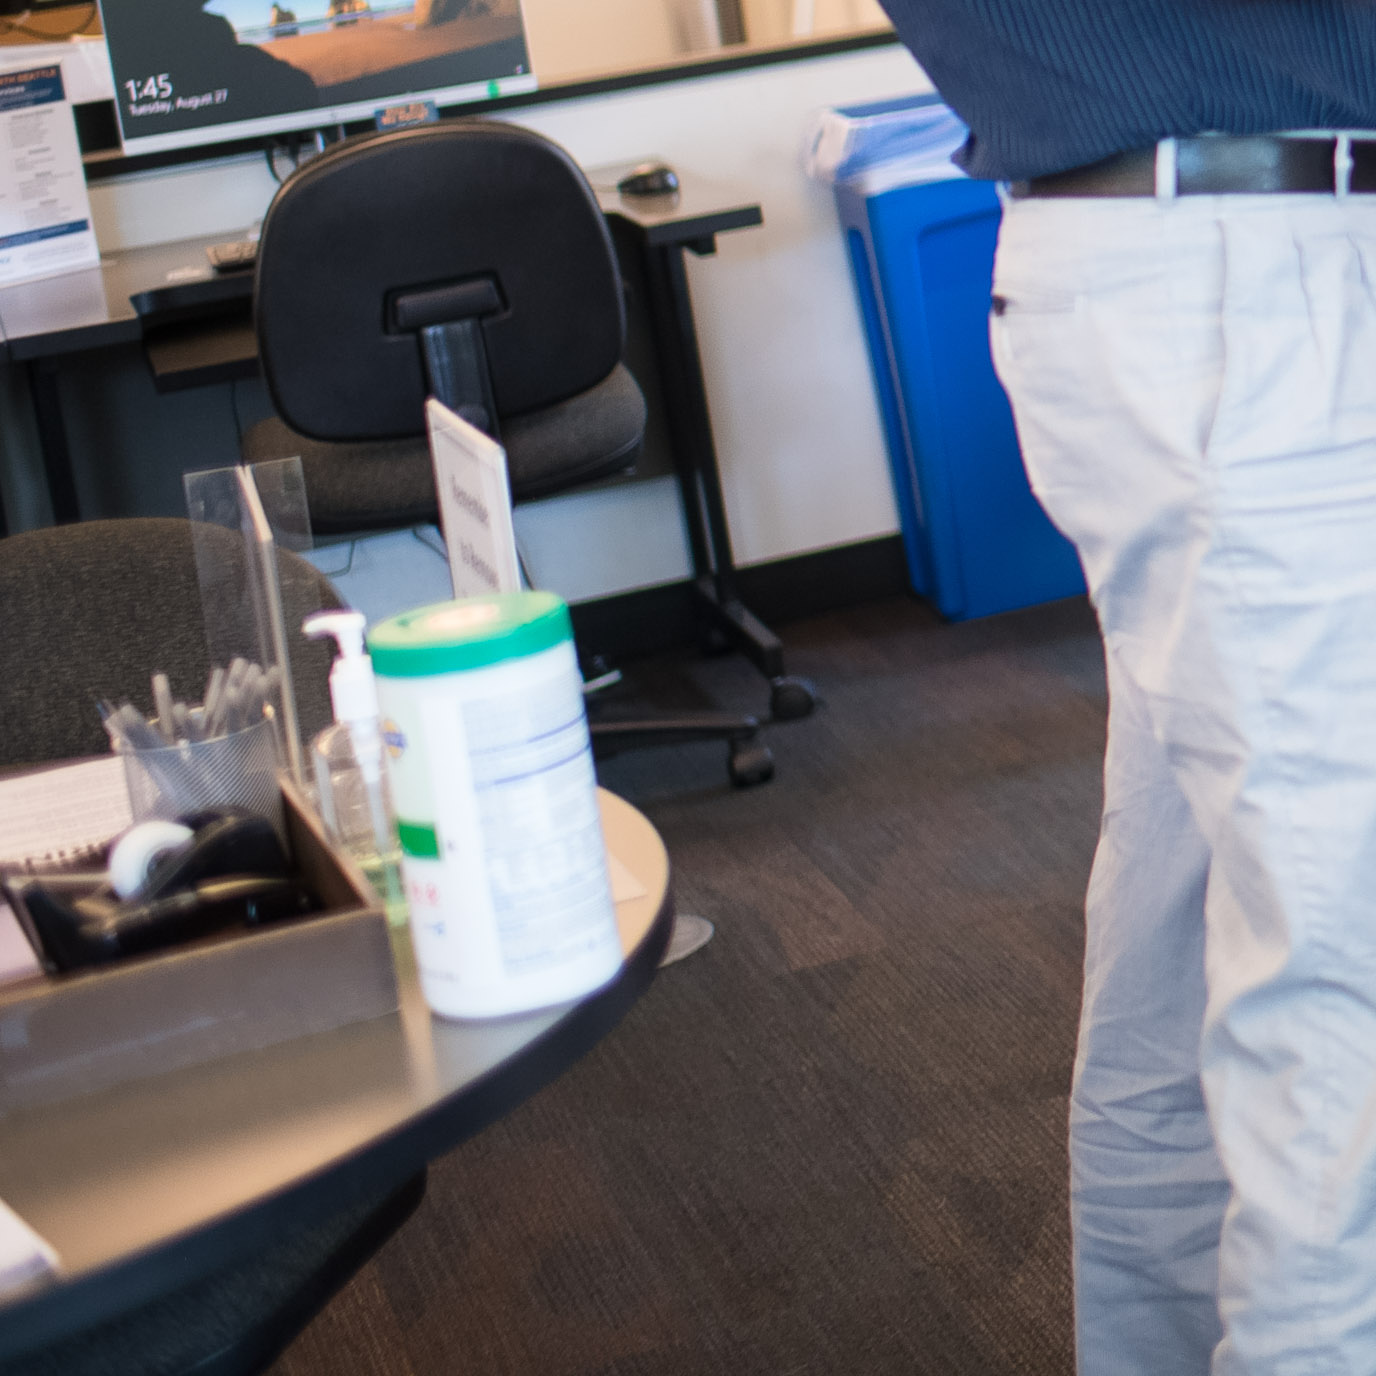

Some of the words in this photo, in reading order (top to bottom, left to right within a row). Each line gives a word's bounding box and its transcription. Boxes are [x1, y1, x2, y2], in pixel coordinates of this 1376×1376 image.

[125, 73, 173, 102] 1:45
[128, 101, 174, 117] Tuesday,
[176, 91, 214, 111] August
[214, 88, 229, 104] 27
